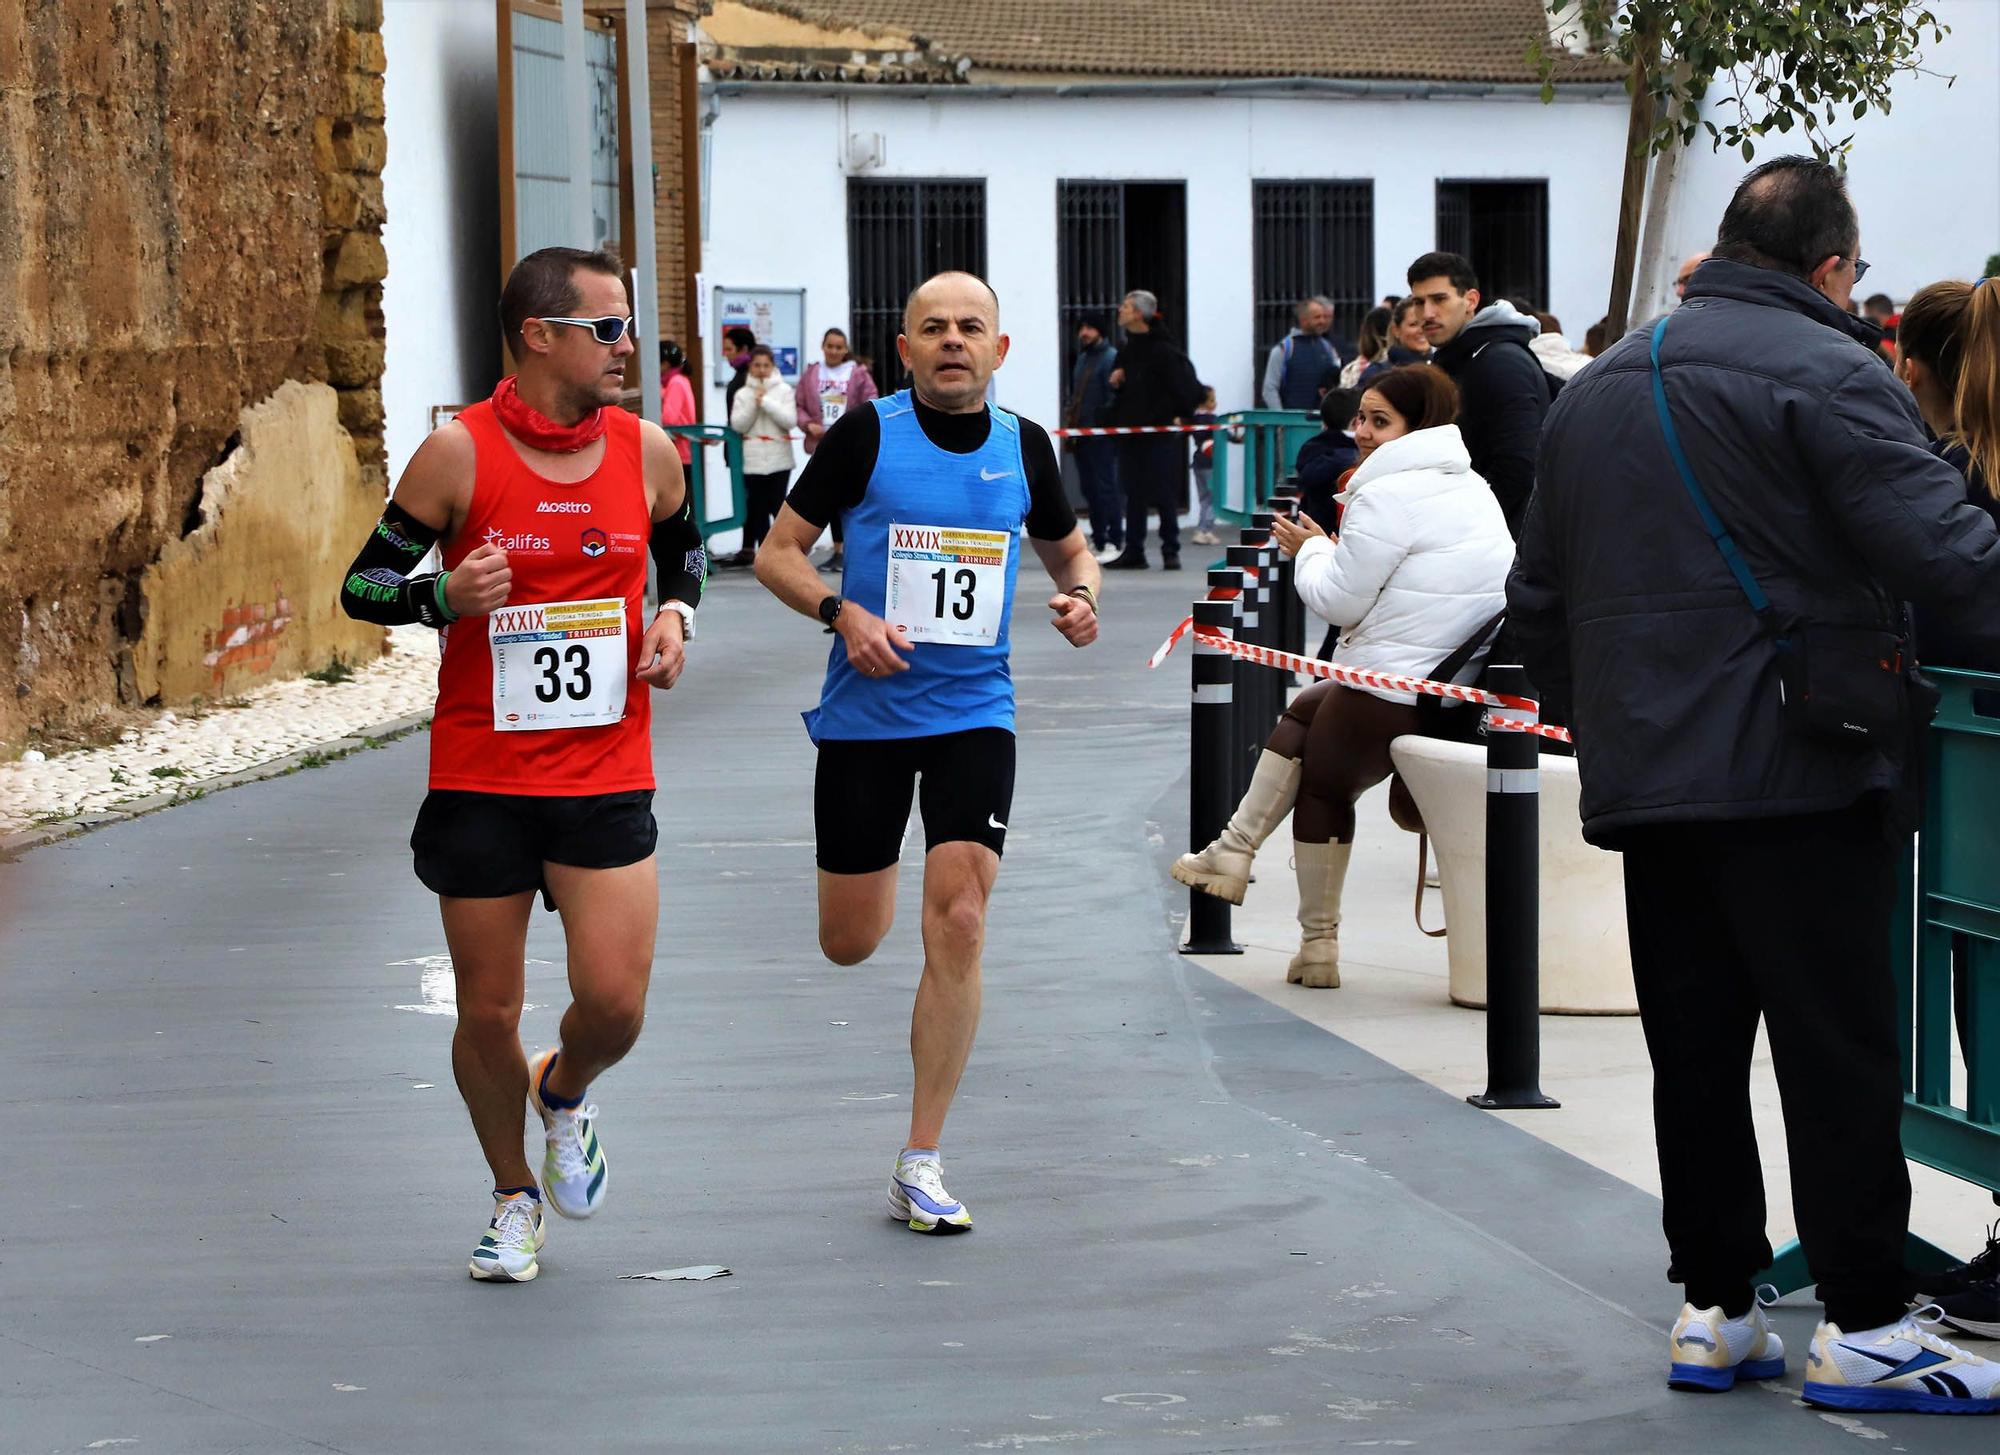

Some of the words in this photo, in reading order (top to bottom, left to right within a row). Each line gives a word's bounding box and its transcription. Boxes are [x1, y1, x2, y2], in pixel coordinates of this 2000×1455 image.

[536, 501, 592, 513] Mosttro
[894, 529, 941, 551] XXXIX
[892, 550, 914, 560] Colegio
[931, 552, 955, 562] Trinidad
[931, 567, 977, 621] 13
[494, 609, 546, 633] XXXIX
[537, 631, 563, 640] Trinidad
[568, 627, 621, 639] TRINITARIOS
[534, 644, 592, 703] 33
